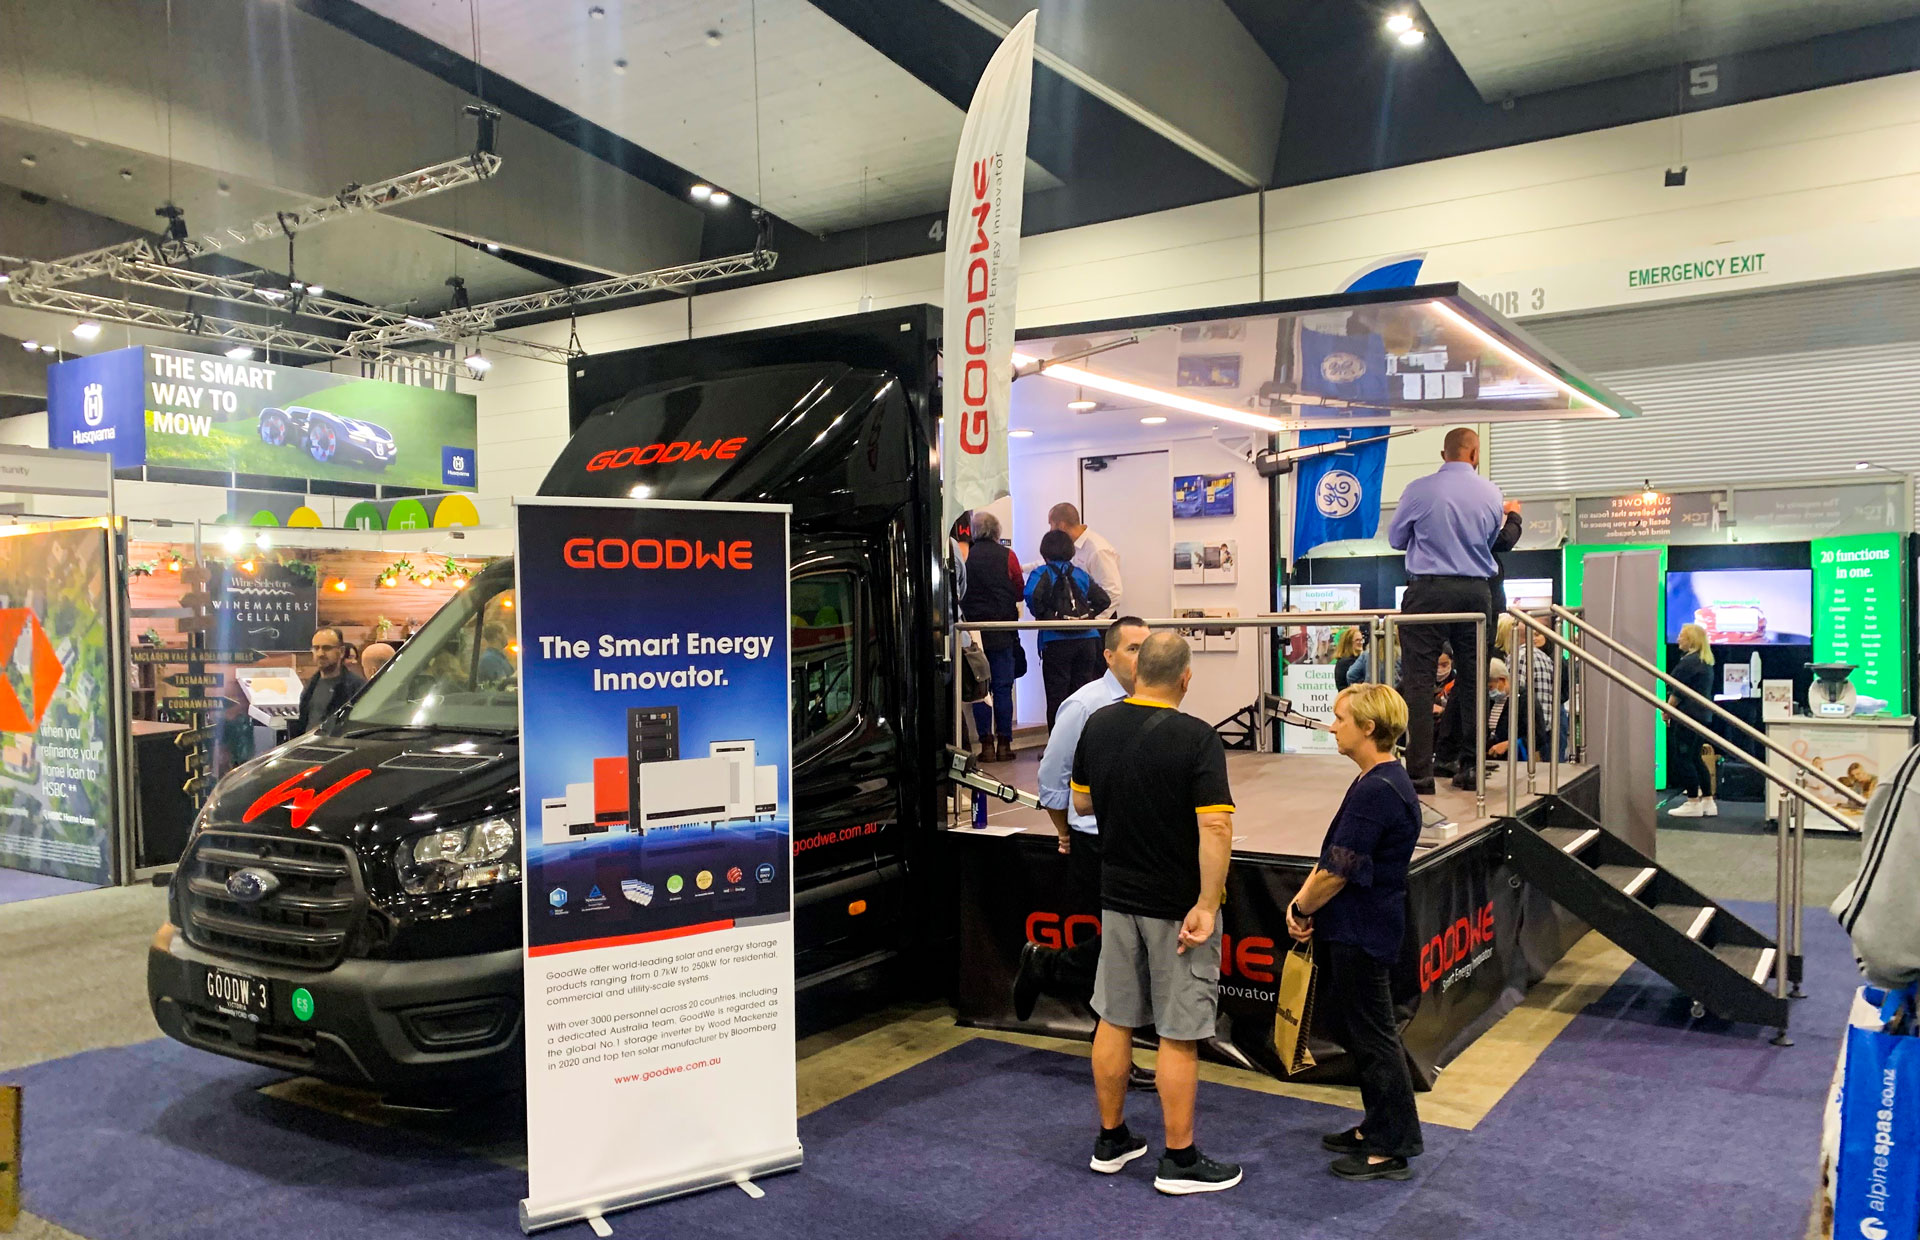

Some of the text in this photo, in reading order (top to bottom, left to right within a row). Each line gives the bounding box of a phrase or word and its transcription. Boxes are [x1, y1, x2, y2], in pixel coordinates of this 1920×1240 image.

[1690, 63, 1718, 95] 5
[928, 219, 944, 241] 4
[988, 240, 1001, 298] Energy
[1629, 253, 1766, 288] EMERGENCY EXIT
[959, 157, 991, 455] GOODWE
[1532, 287, 1545, 310] 3
[151, 353, 276, 390] THE SMART
[152, 382, 237, 413] WAY TO
[73, 427, 116, 445] Husqvarna
[154, 411, 212, 437] MOW
[586, 437, 748, 472] GOODWE
[563, 538, 753, 570] GOODWE
[1821, 548, 1890, 564] 20 functions
[1836, 566, 1873, 579] in one.
[237, 613, 290, 622] CELLAR
[539, 632, 775, 660] The Smart Energy
[175, 675, 216, 685] TASMANIA
[594, 665, 729, 692] Innovator.
[1296, 682, 1335, 691] smarte
[1304, 670, 1335, 679] Clean
[168, 699, 223, 709] COONAWARRA
[1302, 703, 1332, 713] harde
[40, 727, 80, 741] when you
[40, 743, 100, 762] refinance your
[41, 764, 96, 781] home loan to
[546, 939, 778, 981] GoodWe offer world-leading solar and energy storage
[1420, 901, 1494, 993] GOODWE
[546, 980, 588, 995] products
[591, 975, 628, 987] ranging
[630, 973, 651, 982] from
[681, 965, 690, 973] to
[692, 960, 717, 971] 250kW
[719, 958, 730, 966] for
[546, 991, 603, 1006] commercial
[606, 988, 625, 998] and
[627, 980, 676, 996] utility-scale
[1218, 984, 1275, 1002] novator
[547, 1021, 567, 1032] With
[568, 1019, 589, 1029] over
[590, 1015, 612, 1025] 3000
[614, 1007, 659, 1023] personnel
[660, 1003, 688, 1014] across
[689, 1000, 699, 1009] 20
[739, 987, 778, 999] including
[558, 1028, 607, 1043] dedicated
[610, 1022, 649, 1035] Australia
[680, 1008, 715, 1023] GoodWe
[718, 1007, 724, 1015] is
[726, 1001, 766, 1013] regarded
[768, 999, 778, 1007] as
[547, 1049, 563, 1058] the
[566, 1042, 597, 1056] global
[624, 1034, 658, 1046] storage
[661, 1026, 692, 1039] inverter
[694, 1024, 705, 1033] by
[708, 1017, 731, 1029] Wood
[734, 1011, 778, 1024] Mackenzie
[548, 1023, 777, 1071] in 2020 and top ten solar manufacturer by Bloomberg
[614, 1057, 722, 1084] www.goodwe.com.au
[1866, 1069, 1897, 1212] alpinespas.co.nz
